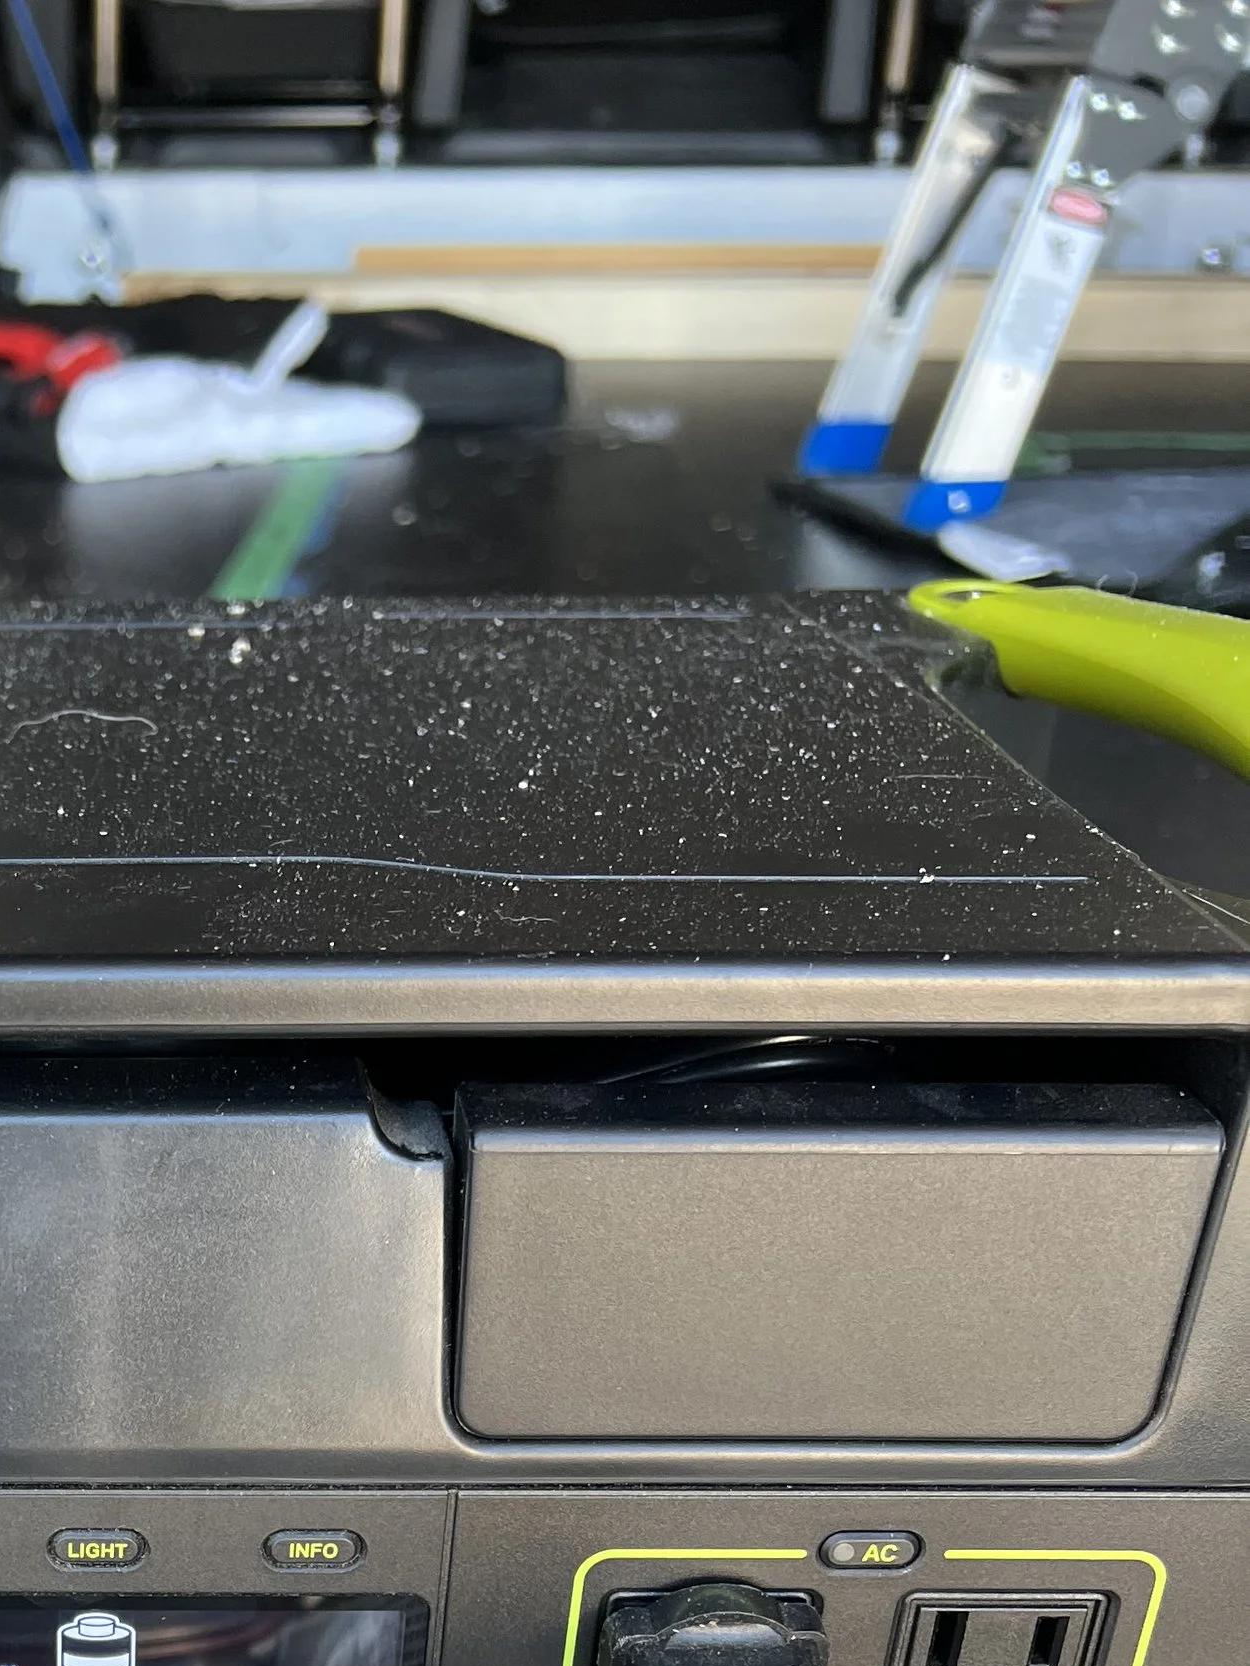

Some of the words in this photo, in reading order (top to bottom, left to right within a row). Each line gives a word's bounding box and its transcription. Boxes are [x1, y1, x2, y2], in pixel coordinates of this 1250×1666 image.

[67, 1542, 128, 1559] LIGHT
[289, 1542, 339, 1559] INFO
[861, 1543, 899, 1563] AC
